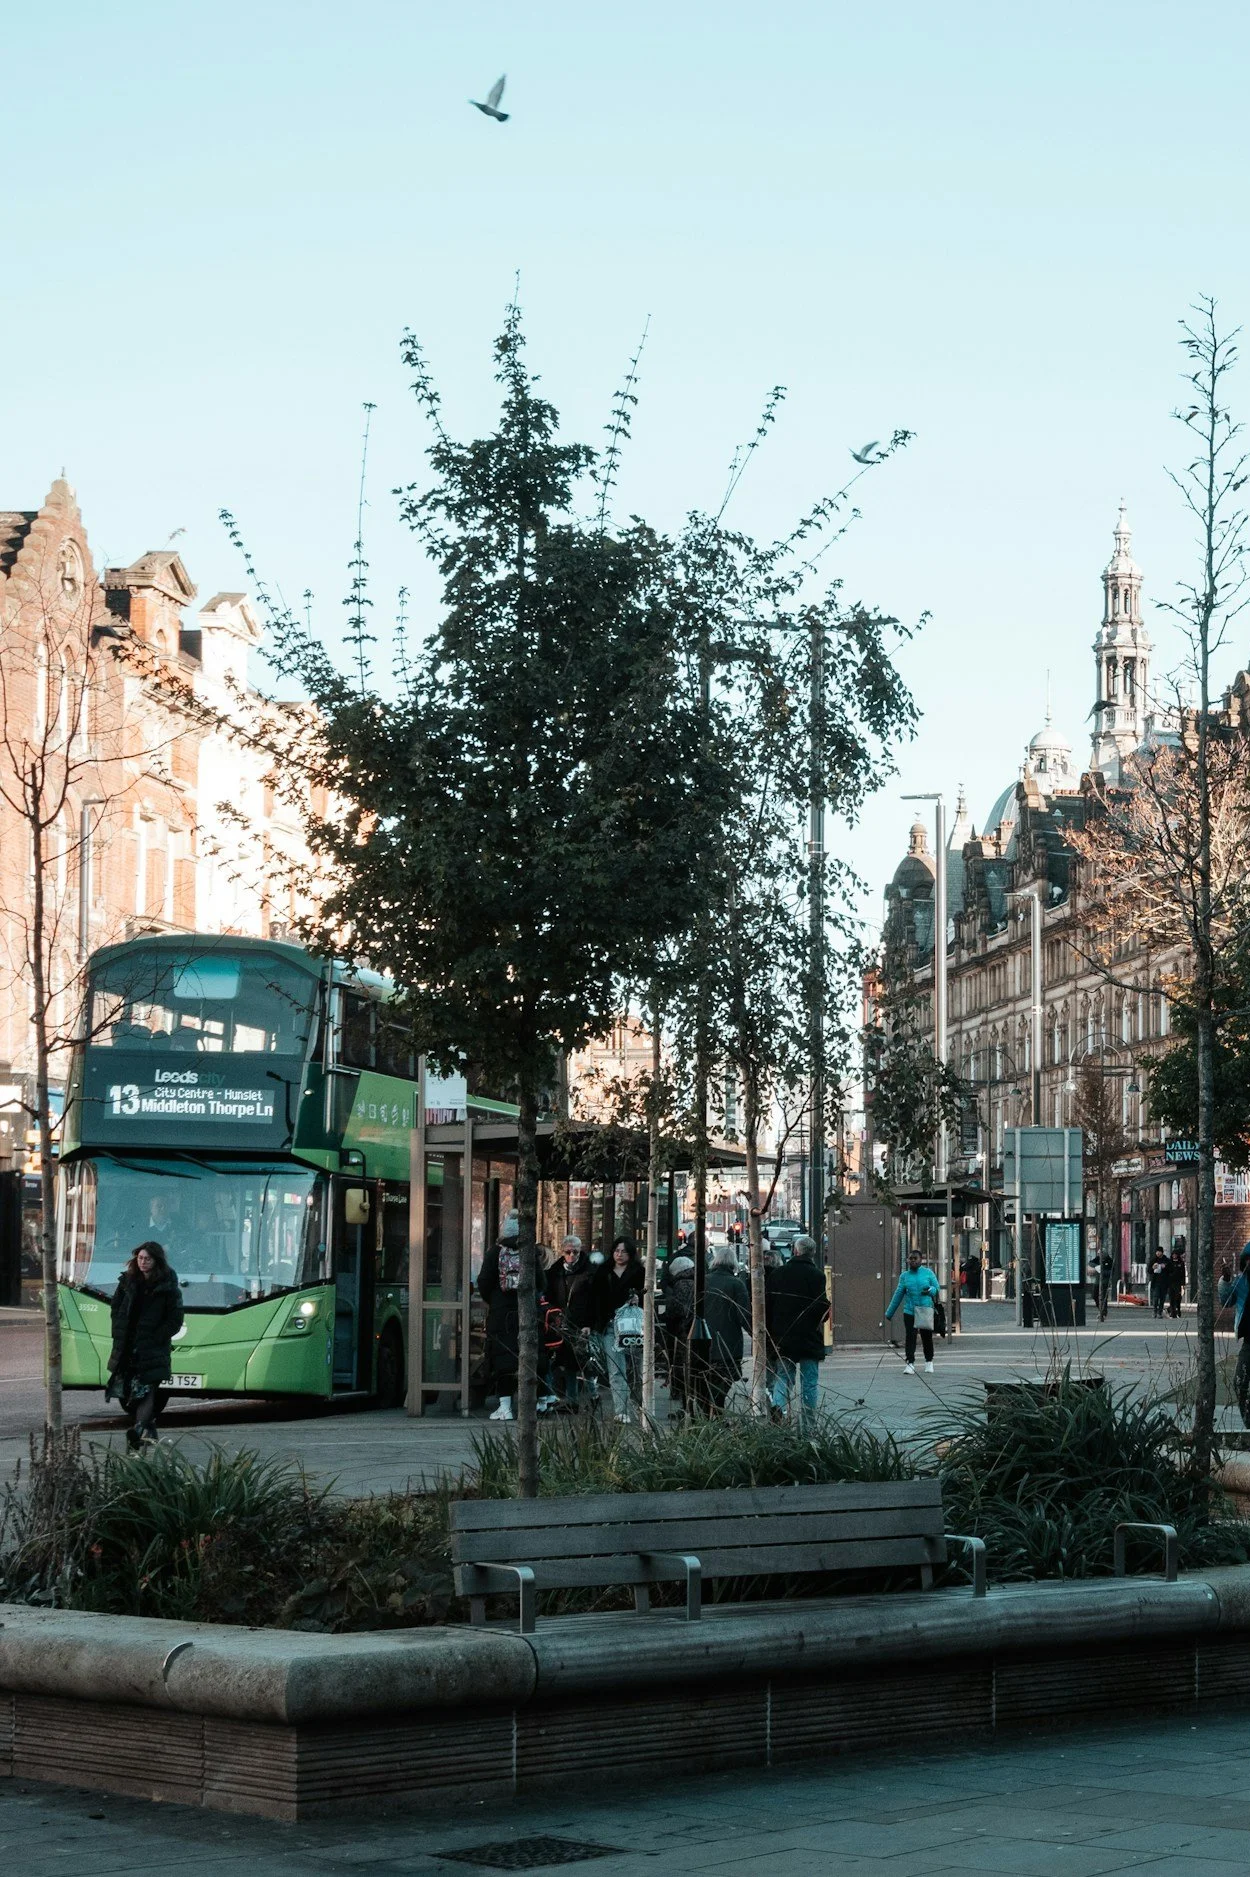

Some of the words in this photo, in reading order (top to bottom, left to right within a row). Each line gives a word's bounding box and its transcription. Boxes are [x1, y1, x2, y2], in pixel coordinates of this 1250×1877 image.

[155, 1069, 198, 1084] Leeds
[200, 1072, 225, 1086] city
[109, 1084, 140, 1115] 13
[154, 1087, 176, 1098] City
[177, 1087, 214, 1099] Centre
[224, 1089, 263, 1101] Hunslet
[141, 1099, 205, 1114] Middleton
[208, 1101, 254, 1118] Thorpe
[256, 1102, 273, 1116] Ln
[1166, 1140, 1200, 1150] DAILY
[1166, 1151, 1200, 1161] NEWS
[623, 1337, 644, 1346] aso
[177, 1376, 197, 1387] TSZ
